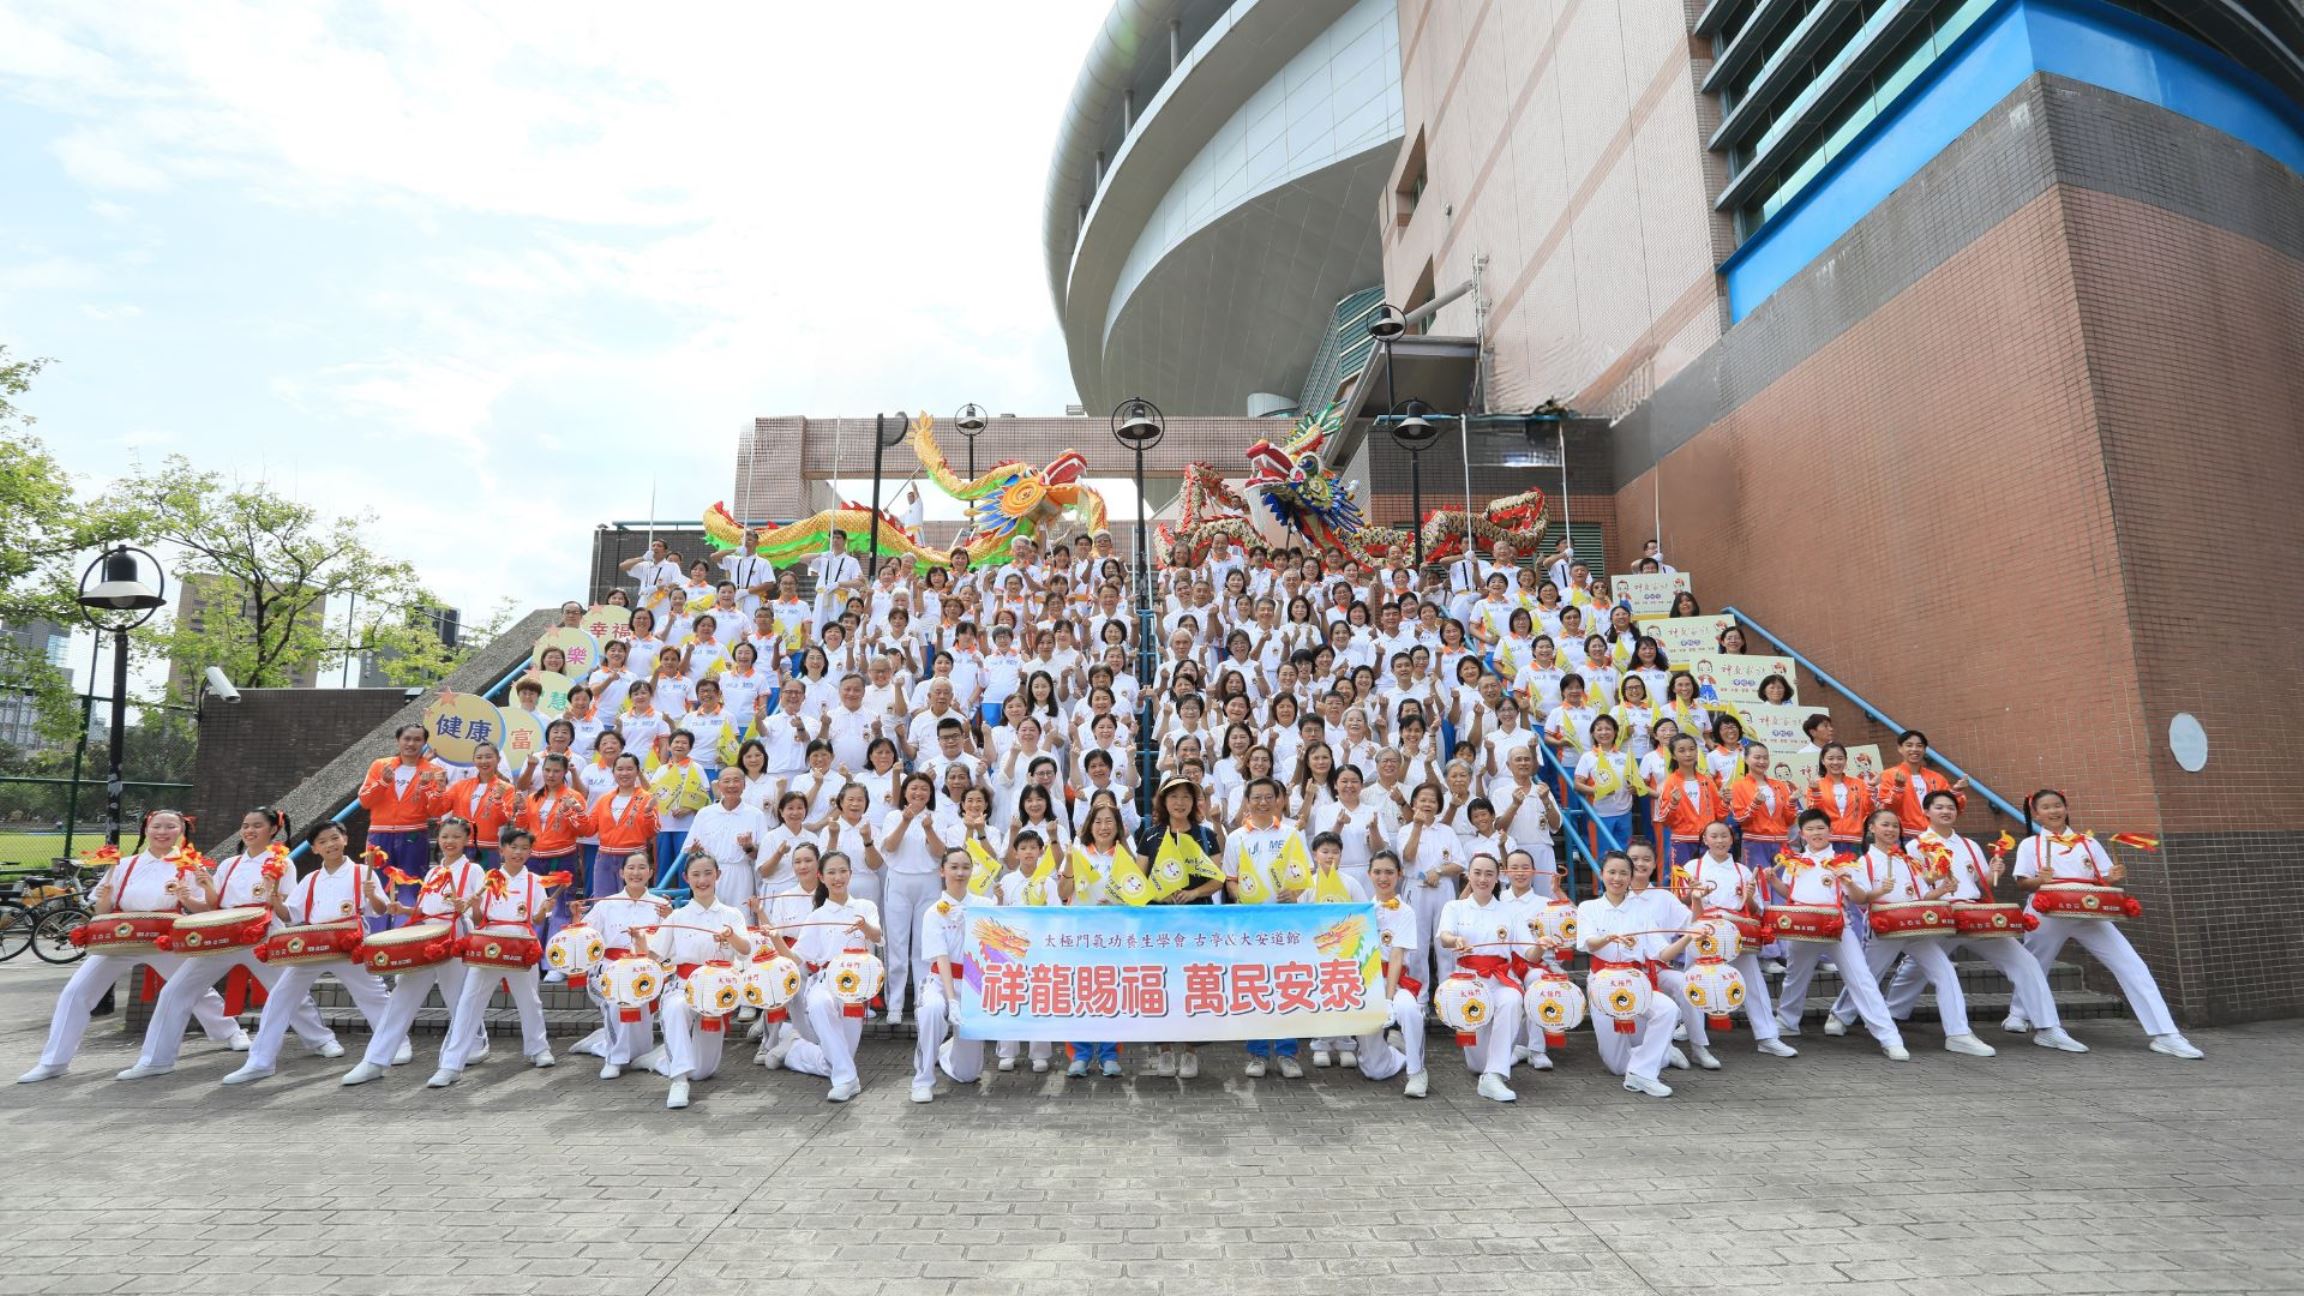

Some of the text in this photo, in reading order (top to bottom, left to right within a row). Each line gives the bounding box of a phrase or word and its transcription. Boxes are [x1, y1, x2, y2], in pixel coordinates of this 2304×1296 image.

[589, 622, 631, 638] 幸福
[436, 714, 492, 742] 健康
[1044, 933, 1187, 948] 太極門氣功養生學會
[982, 959, 1366, 1017] 祥龍賜福 萬民安泰
